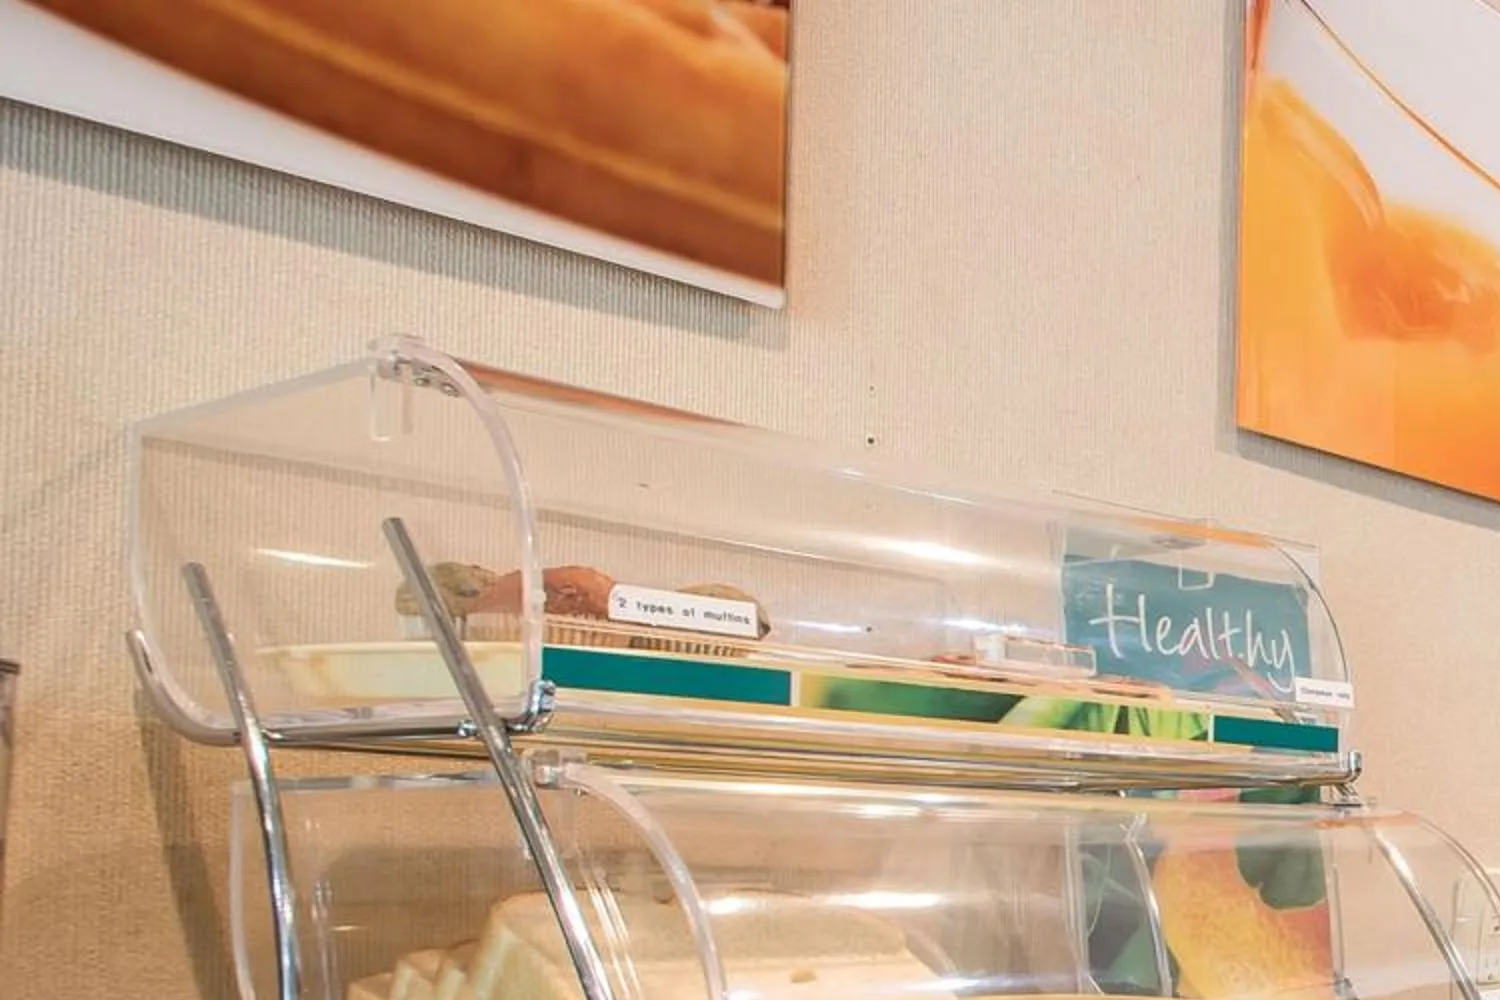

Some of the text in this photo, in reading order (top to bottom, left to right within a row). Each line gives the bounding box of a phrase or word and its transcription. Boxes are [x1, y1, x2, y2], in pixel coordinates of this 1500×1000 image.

[617, 597, 751, 625] 2 types of muffins
[1088, 582, 1296, 693] Healthy
